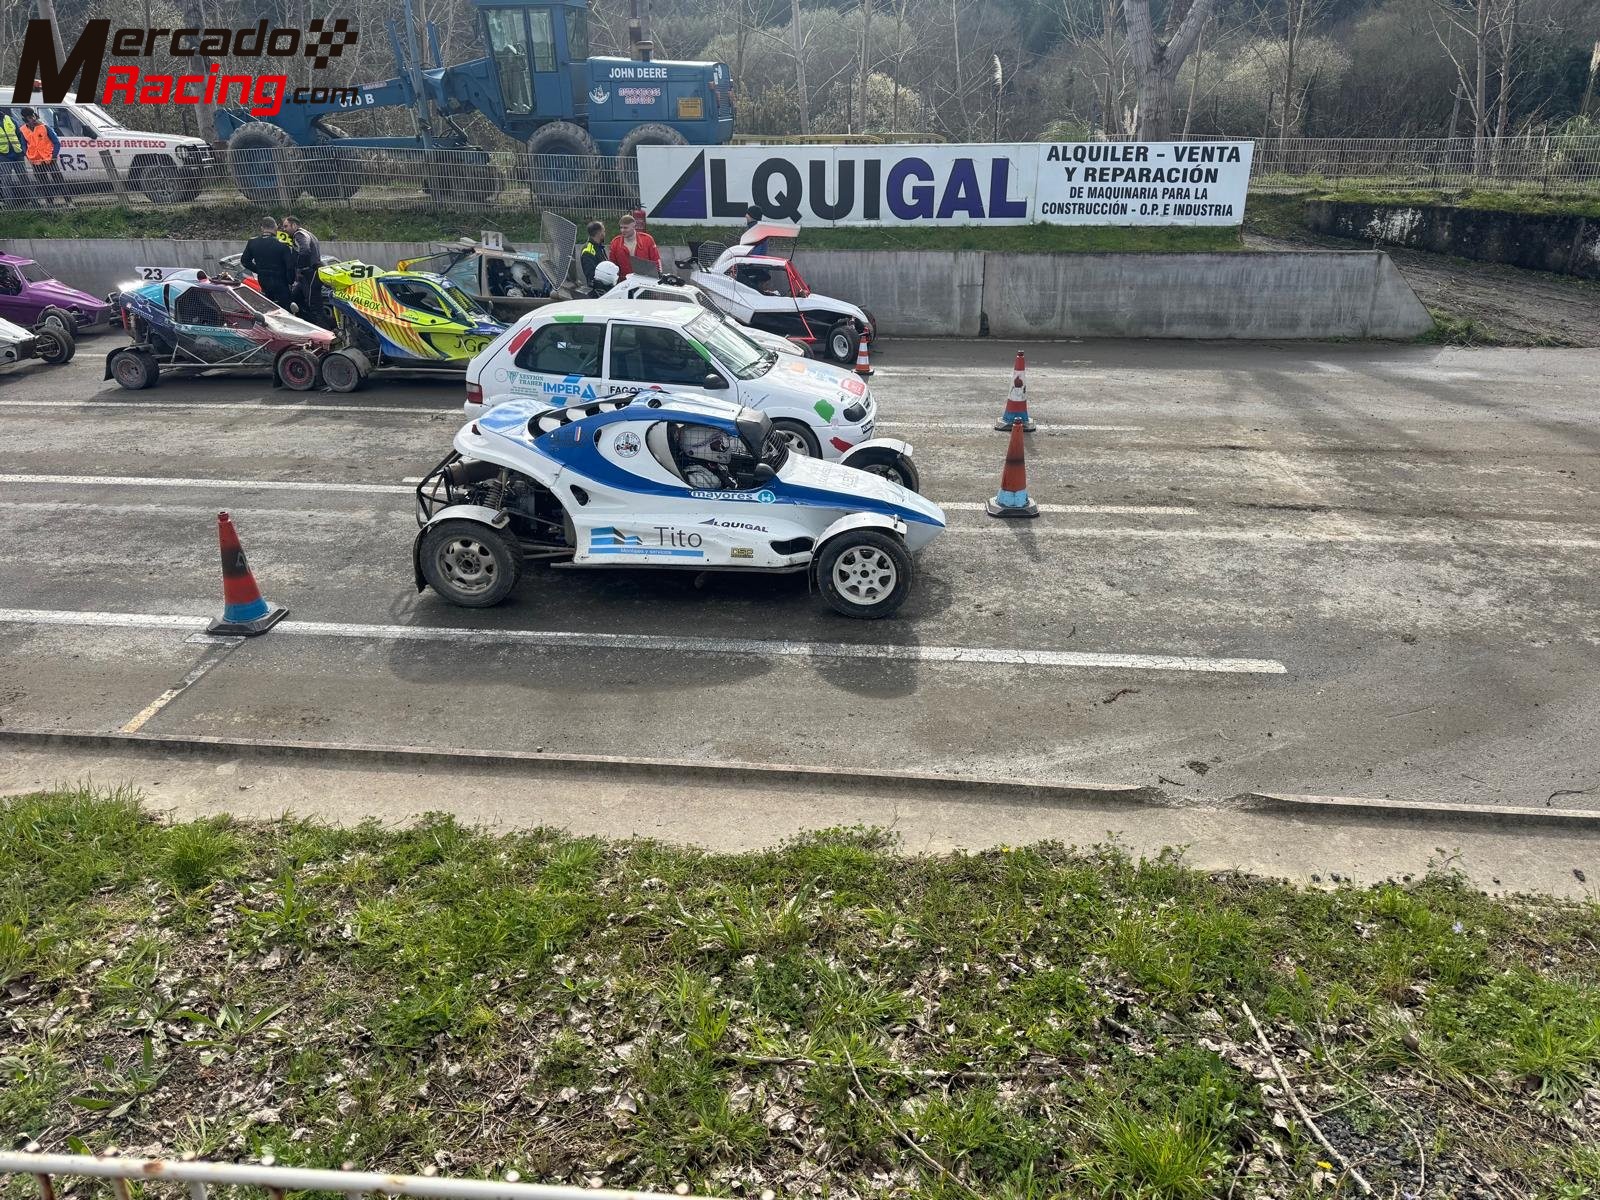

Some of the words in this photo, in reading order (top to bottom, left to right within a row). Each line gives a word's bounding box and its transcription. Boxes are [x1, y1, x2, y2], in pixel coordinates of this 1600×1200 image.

[609, 67, 635, 79] JOHN
[637, 67, 668, 79] DEERE
[60, 140, 121, 148] AUTOCROSS
[124, 140, 167, 149] ARTEIXO
[1046, 145, 1149, 163] ALQUILER
[1173, 146, 1241, 163] VENTA
[1064, 167, 1078, 182] Y
[1083, 163, 1219, 183] REPARACIÓN
[1069, 186, 1084, 199] DE
[1087, 186, 1159, 200] MAQUINARIA
[1161, 187, 1192, 200] PARA
[1194, 188, 1208, 200] LA
[1041, 200, 1128, 215] CONSTRUCCIÓN
[1139, 203, 1159, 216] O.P.
[1163, 203, 1170, 216] E
[1173, 203, 1233, 217] INDUSTRIA
[143, 268, 163, 281] 23
[350, 265, 374, 279] 31
[692, 490, 753, 501] mayores
[654, 526, 703, 548] Tito
